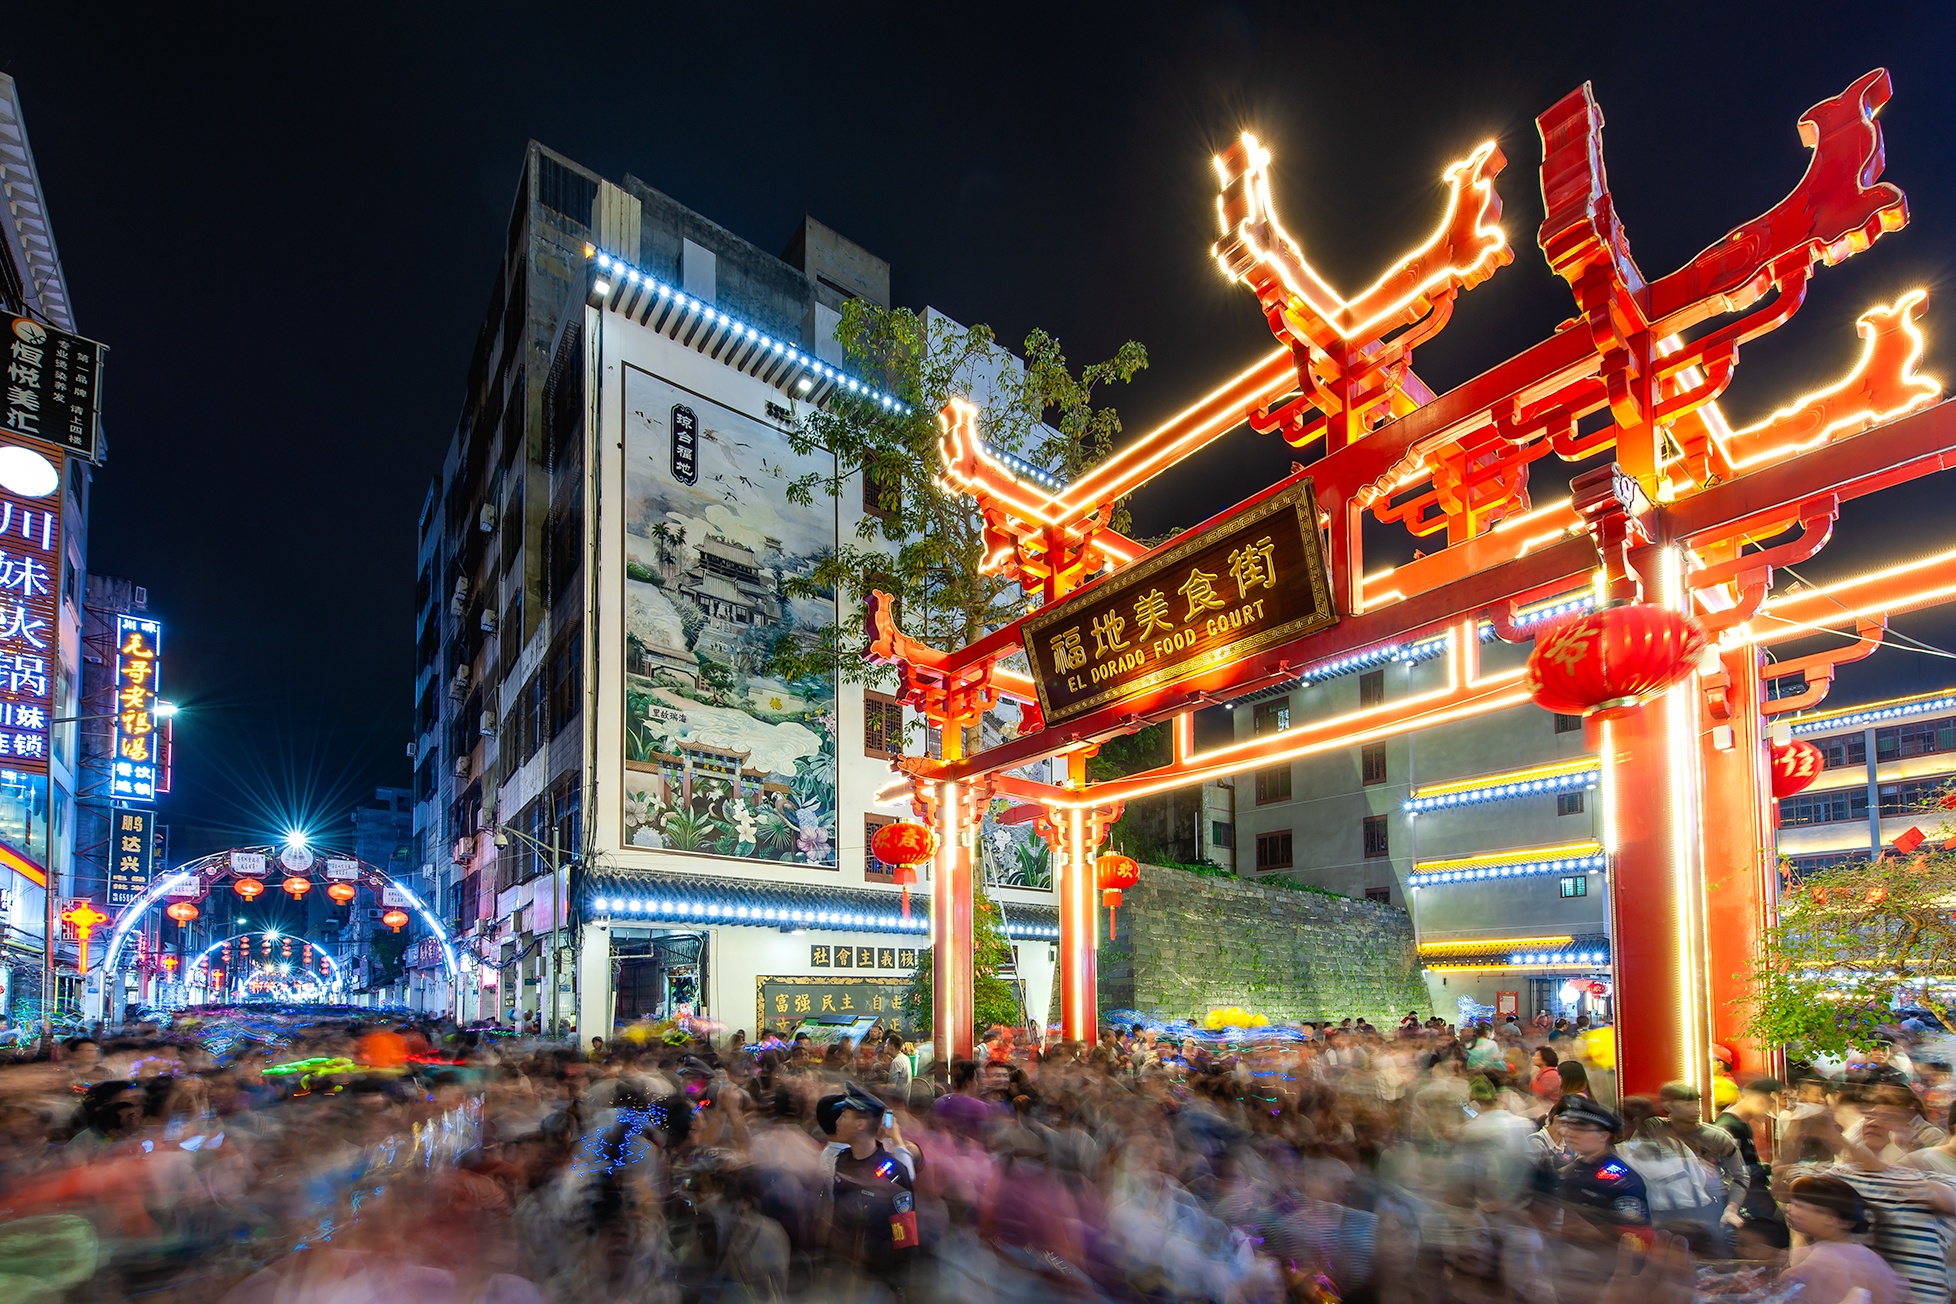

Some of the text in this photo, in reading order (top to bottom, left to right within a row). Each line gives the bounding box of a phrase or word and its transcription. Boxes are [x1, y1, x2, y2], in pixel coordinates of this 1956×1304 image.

[7, 340, 44, 434] 恒悦美汇
[69, 352, 90, 445] 第一品牌 请上四楼
[0, 501, 53, 696] 川妹火锅
[1050, 535, 1277, 676] 福地美食街
[1068, 598, 1266, 693] EL DORADO FOOD COURT
[120, 814, 143, 873] 鹏达兴
[775, 993, 902, 1013] 富强 民主 自由
